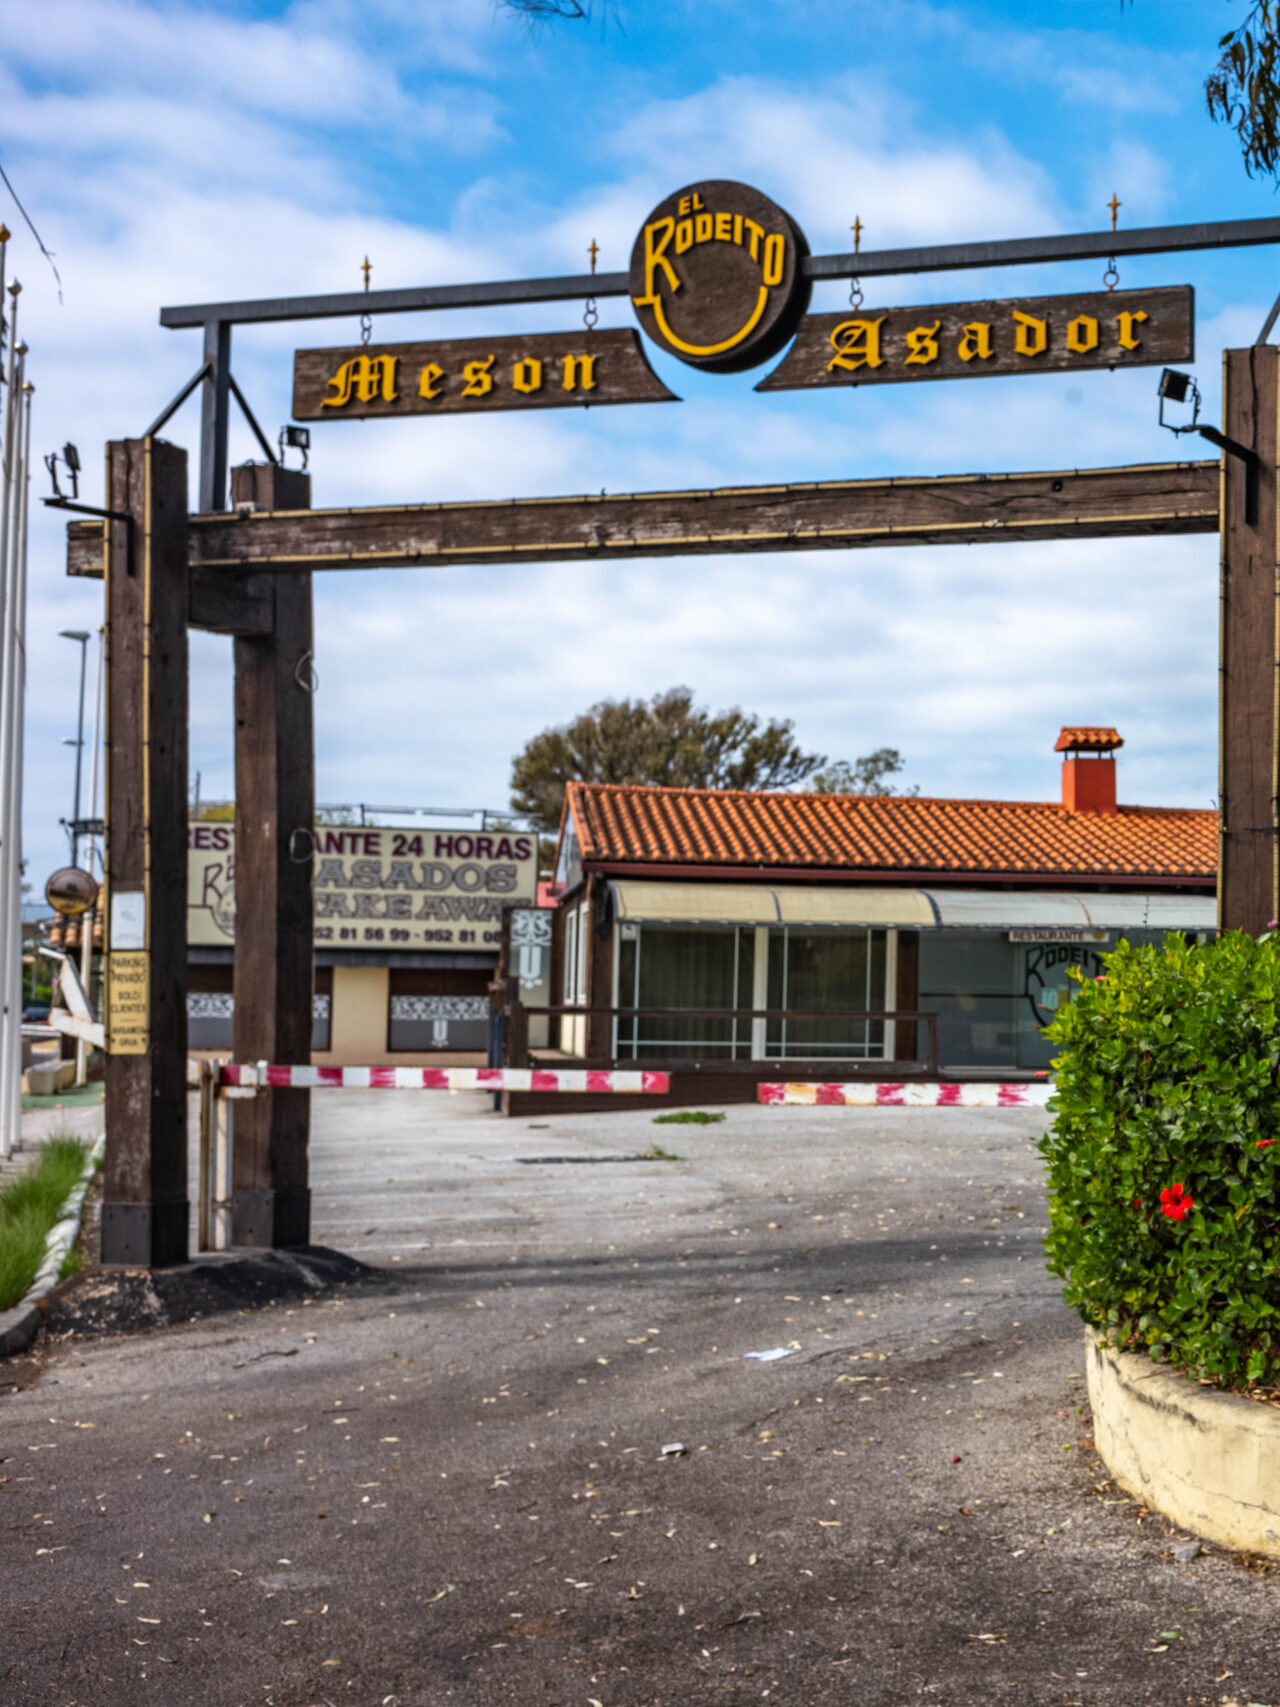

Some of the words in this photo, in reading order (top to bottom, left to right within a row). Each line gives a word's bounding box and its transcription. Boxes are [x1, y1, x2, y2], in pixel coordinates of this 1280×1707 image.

[678, 193, 704, 216] EL
[644, 212, 785, 298] RODEITO
[826, 309, 1149, 372] Asador
[320, 353, 596, 407] Meson
[391, 834, 424, 857] 24
[434, 834, 533, 861] HORAS
[314, 859, 519, 893] ASADOS
[424, 929, 453, 942] 952
[1012, 930, 1085, 941] RESTAURANTE
[1025, 944, 1106, 996] RODEIT
